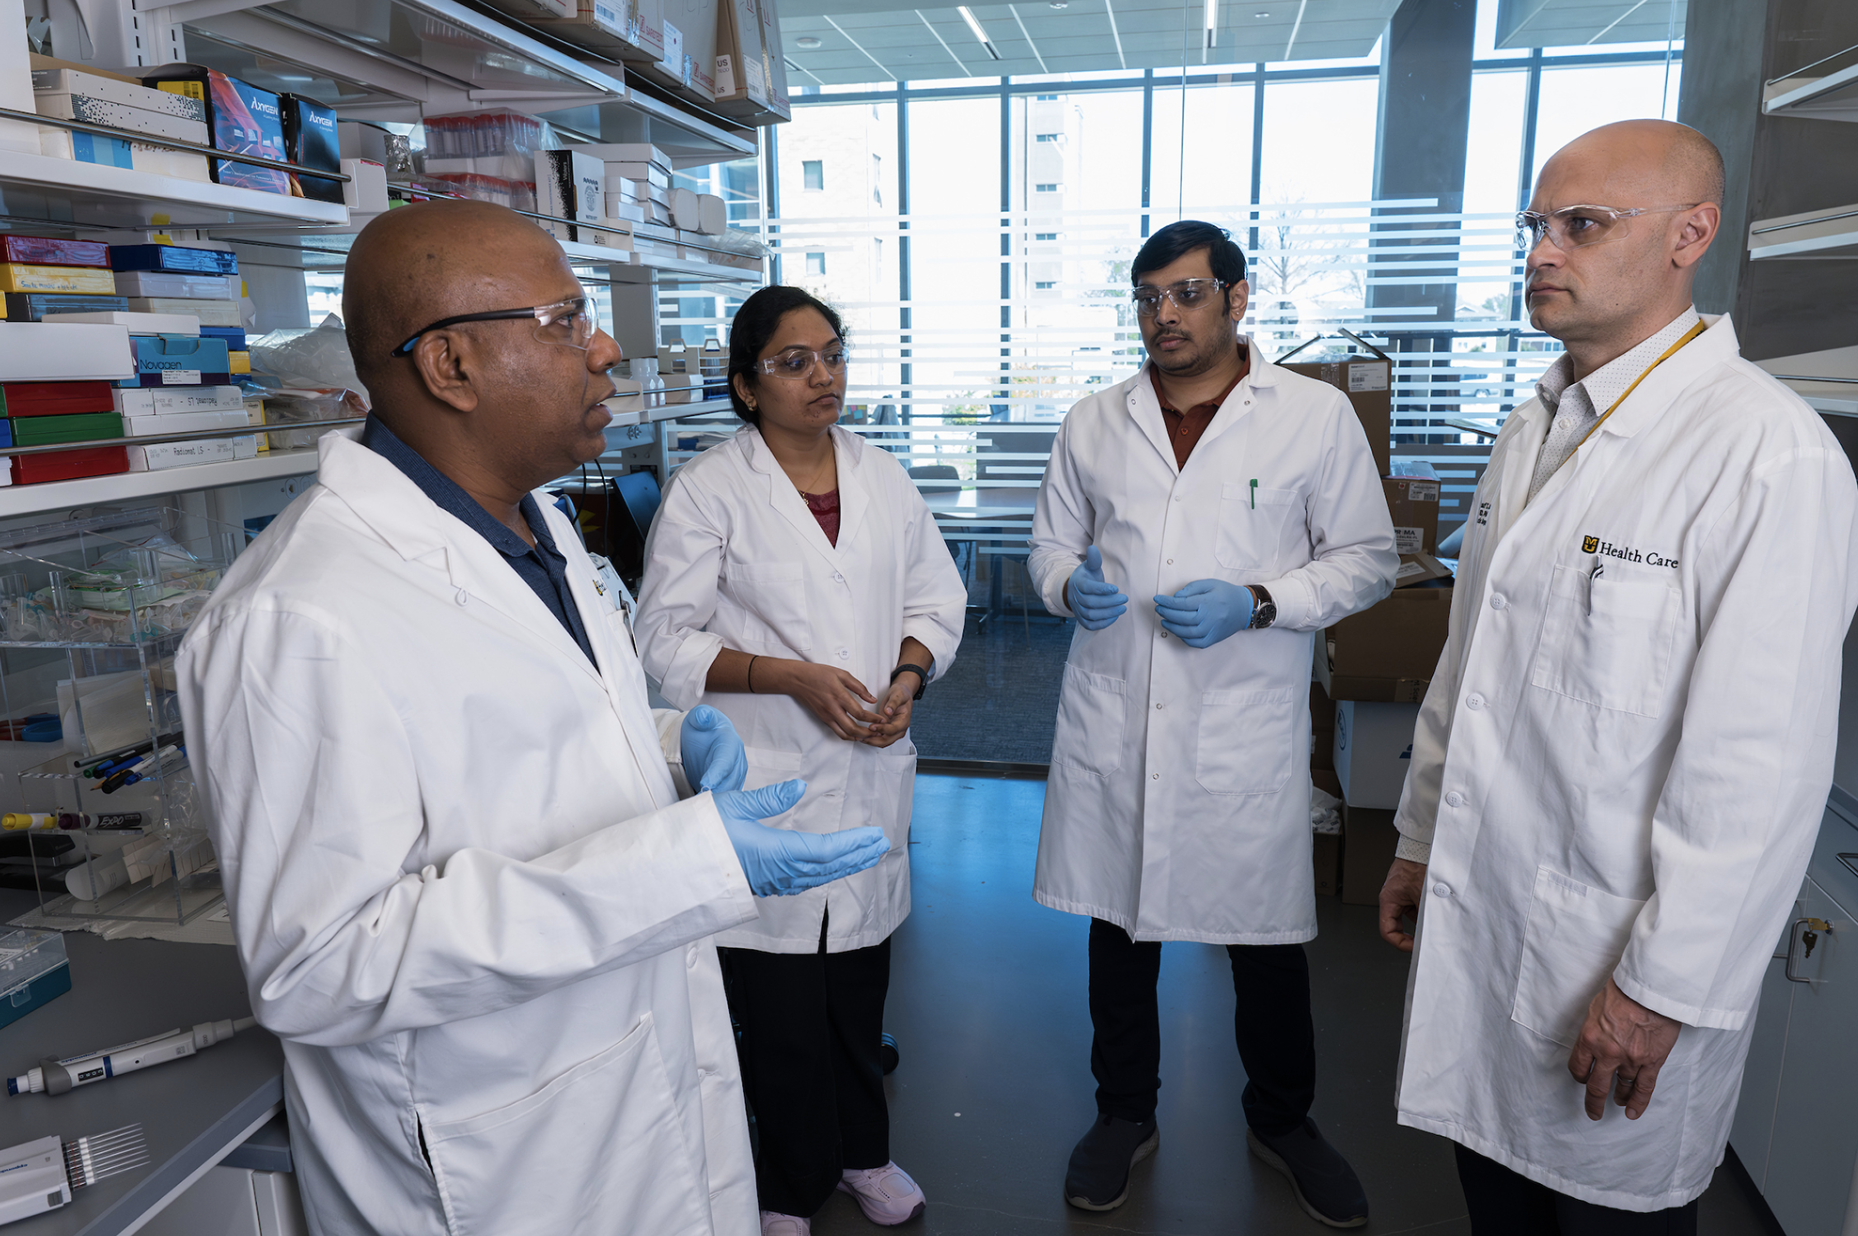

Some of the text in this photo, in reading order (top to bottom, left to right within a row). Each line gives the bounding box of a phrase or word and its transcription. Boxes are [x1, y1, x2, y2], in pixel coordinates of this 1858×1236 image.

[716, 58, 728, 68] US
[716, 86, 726, 94] US
[251, 97, 279, 115] AXYGEN
[309, 110, 333, 128] AXYGEN
[1599, 541, 1642, 563] Health
[1646, 552, 1679, 569] Care
[99, 816, 124, 828] EXPO
